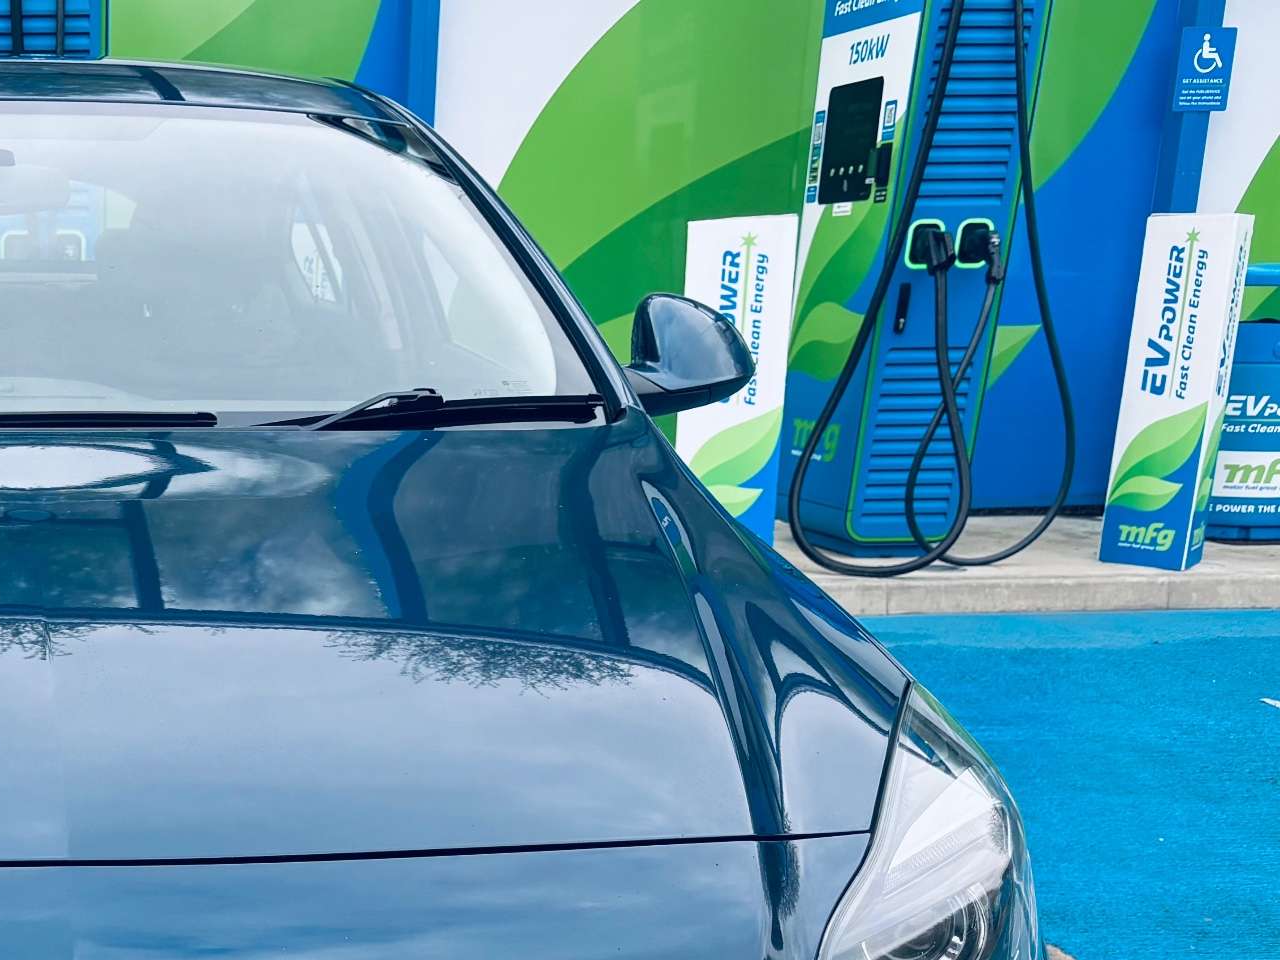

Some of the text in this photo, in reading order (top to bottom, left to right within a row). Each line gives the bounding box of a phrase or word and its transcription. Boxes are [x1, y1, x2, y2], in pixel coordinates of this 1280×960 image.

[849, 33, 890, 65] 150kW
[750, 253, 769, 314] Energy
[1175, 249, 1209, 400] Fast Clean Energy
[743, 371, 758, 405] Fas
[1221, 423, 1280, 433] Fast Clean
[1215, 503, 1255, 513] POWER
[1257, 504, 1277, 513] THE
[1118, 522, 1176, 551] mfg
